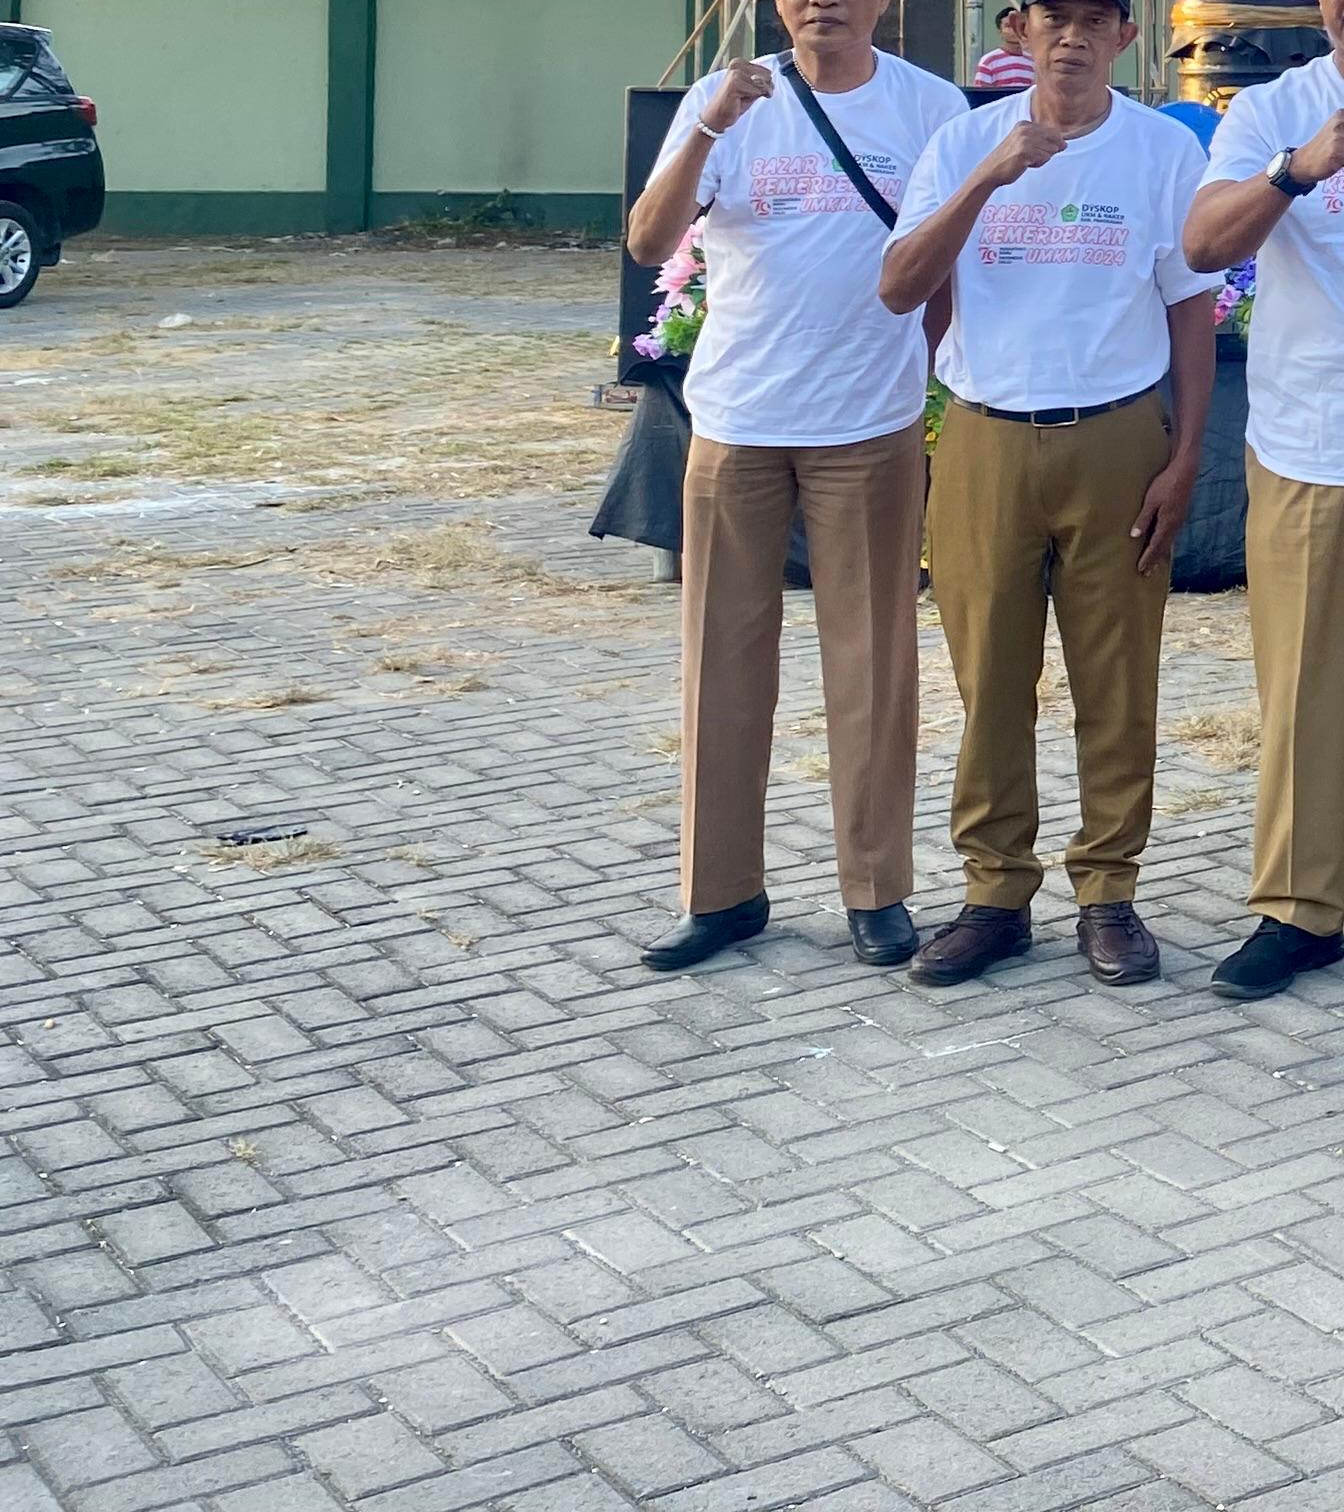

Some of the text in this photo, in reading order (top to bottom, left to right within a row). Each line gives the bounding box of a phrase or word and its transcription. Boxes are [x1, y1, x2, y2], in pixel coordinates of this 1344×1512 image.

[751, 155, 818, 176] BAZAR
[800, 197, 853, 214] UMKM
[982, 205, 1048, 225] BAZAR
[979, 225, 1129, 246] KEMERDEKAAN
[1026, 248, 1079, 264] UMKM
[1083, 248, 1126, 266] 2024
